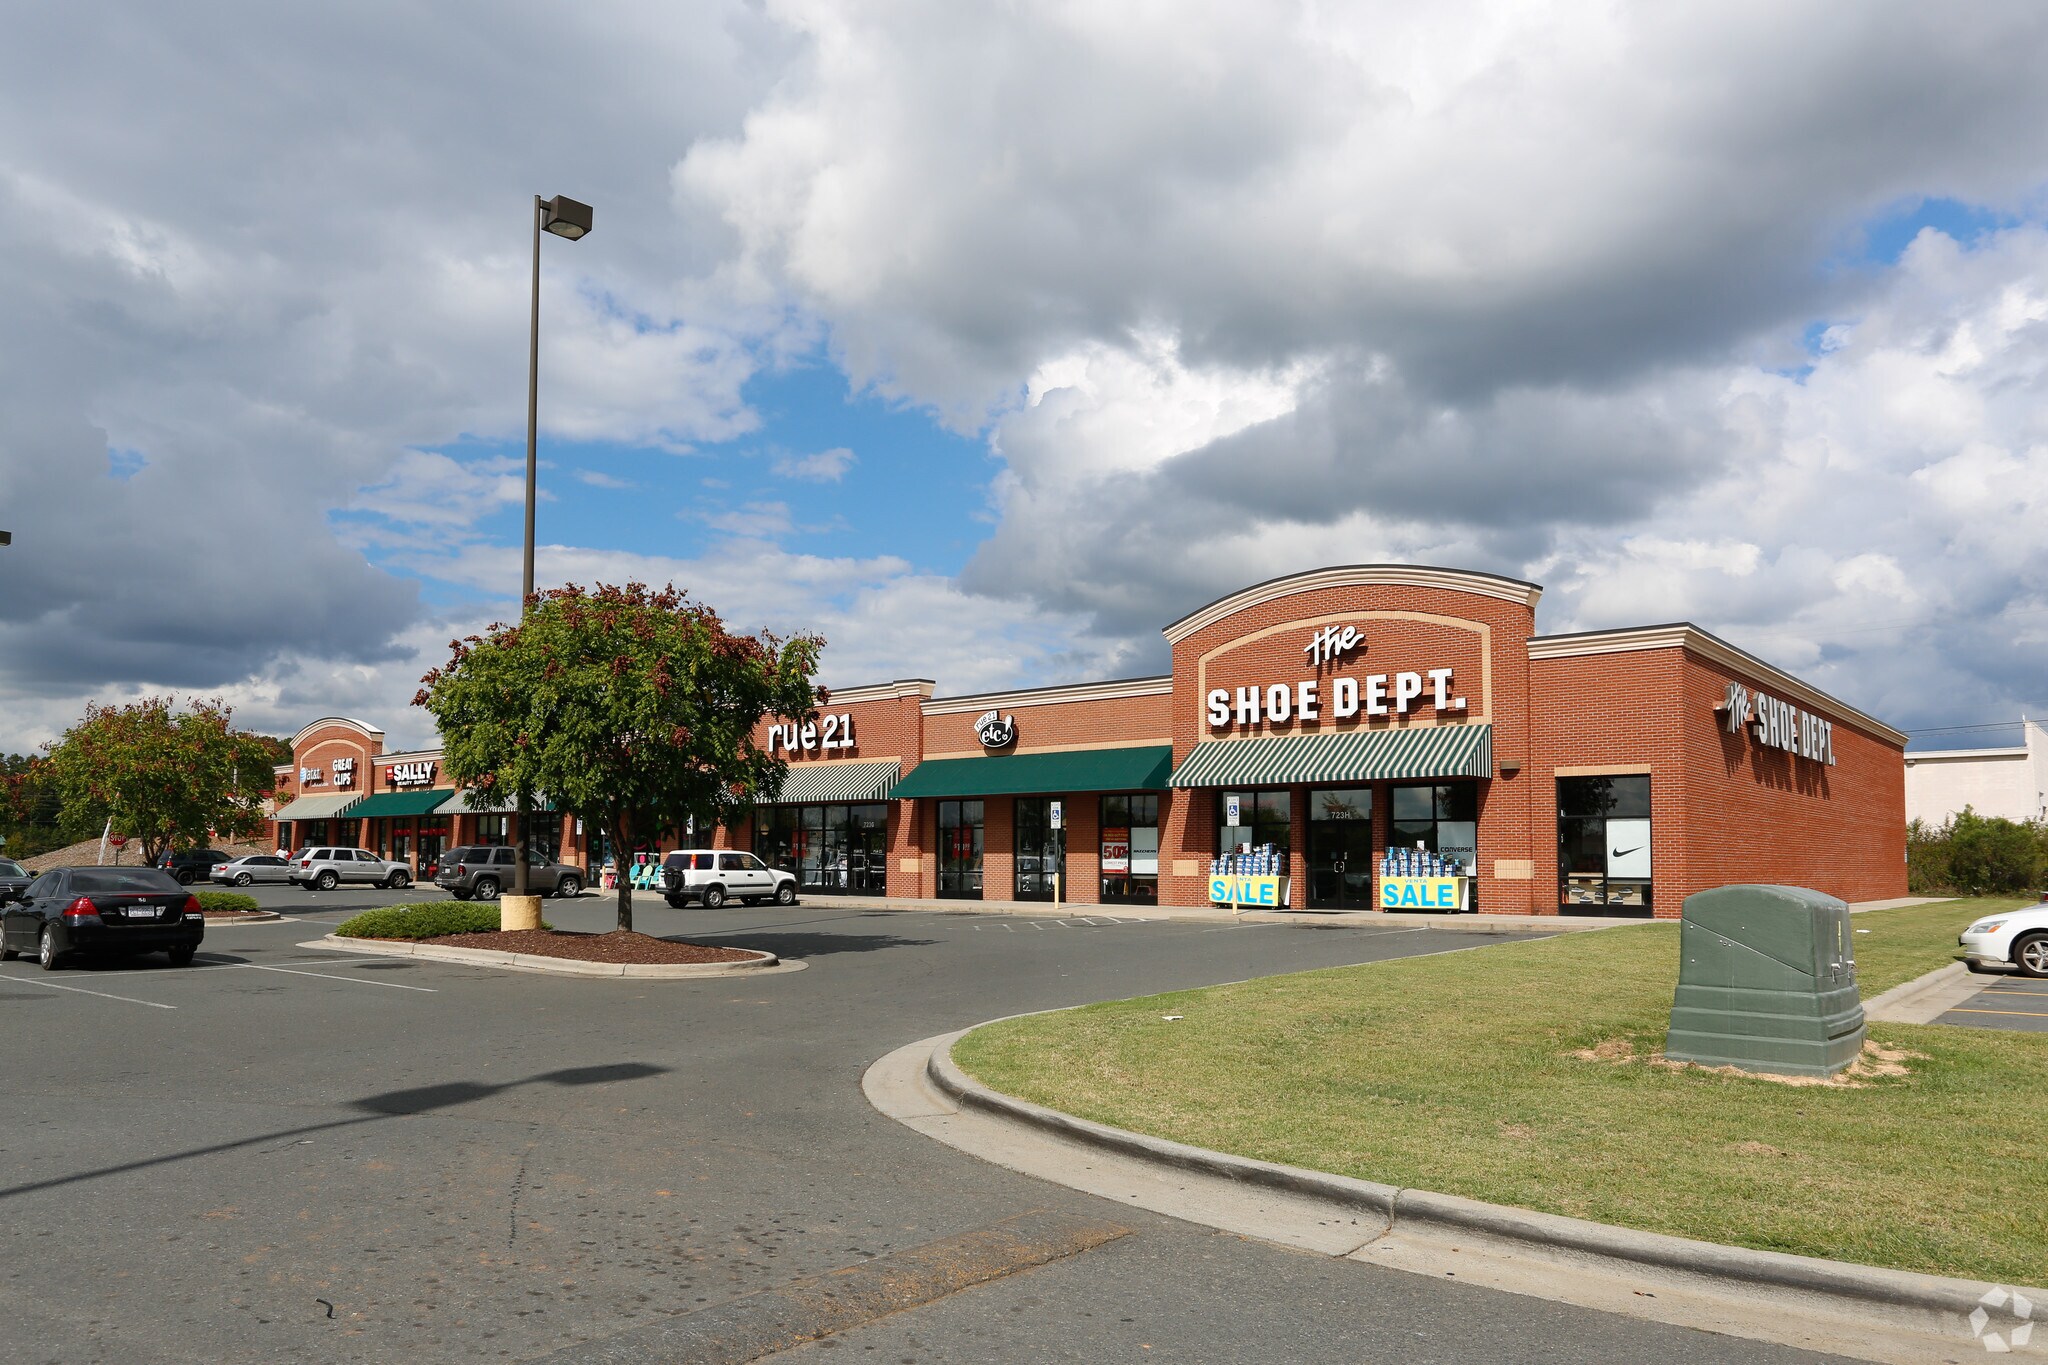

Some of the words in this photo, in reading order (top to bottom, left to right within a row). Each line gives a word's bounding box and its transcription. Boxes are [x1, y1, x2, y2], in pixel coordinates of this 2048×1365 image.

[1304, 625, 1365, 666] the
[1207, 680, 1319, 728] SHOE
[1333, 668, 1467, 718] DEPT.
[975, 716, 988, 729] rue
[987, 711, 996, 720] 21
[1725, 681, 1751, 734] the
[1756, 691, 1798, 754] SHOE
[1800, 709, 1836, 767] DEPT.
[768, 720, 817, 753] rue
[822, 713, 854, 748] 21
[306, 767, 321, 781] at&t
[332, 758, 353, 772] GREAT
[393, 762, 434, 781] SALLY
[333, 772, 351, 786] CLIPS
[1331, 811, 1350, 819] 723H
[110, 834, 126, 842] STOP
[1103, 845, 1129, 859] 50%
[1211, 880, 1274, 904] SALE
[1383, 883, 1454, 907] SALE
